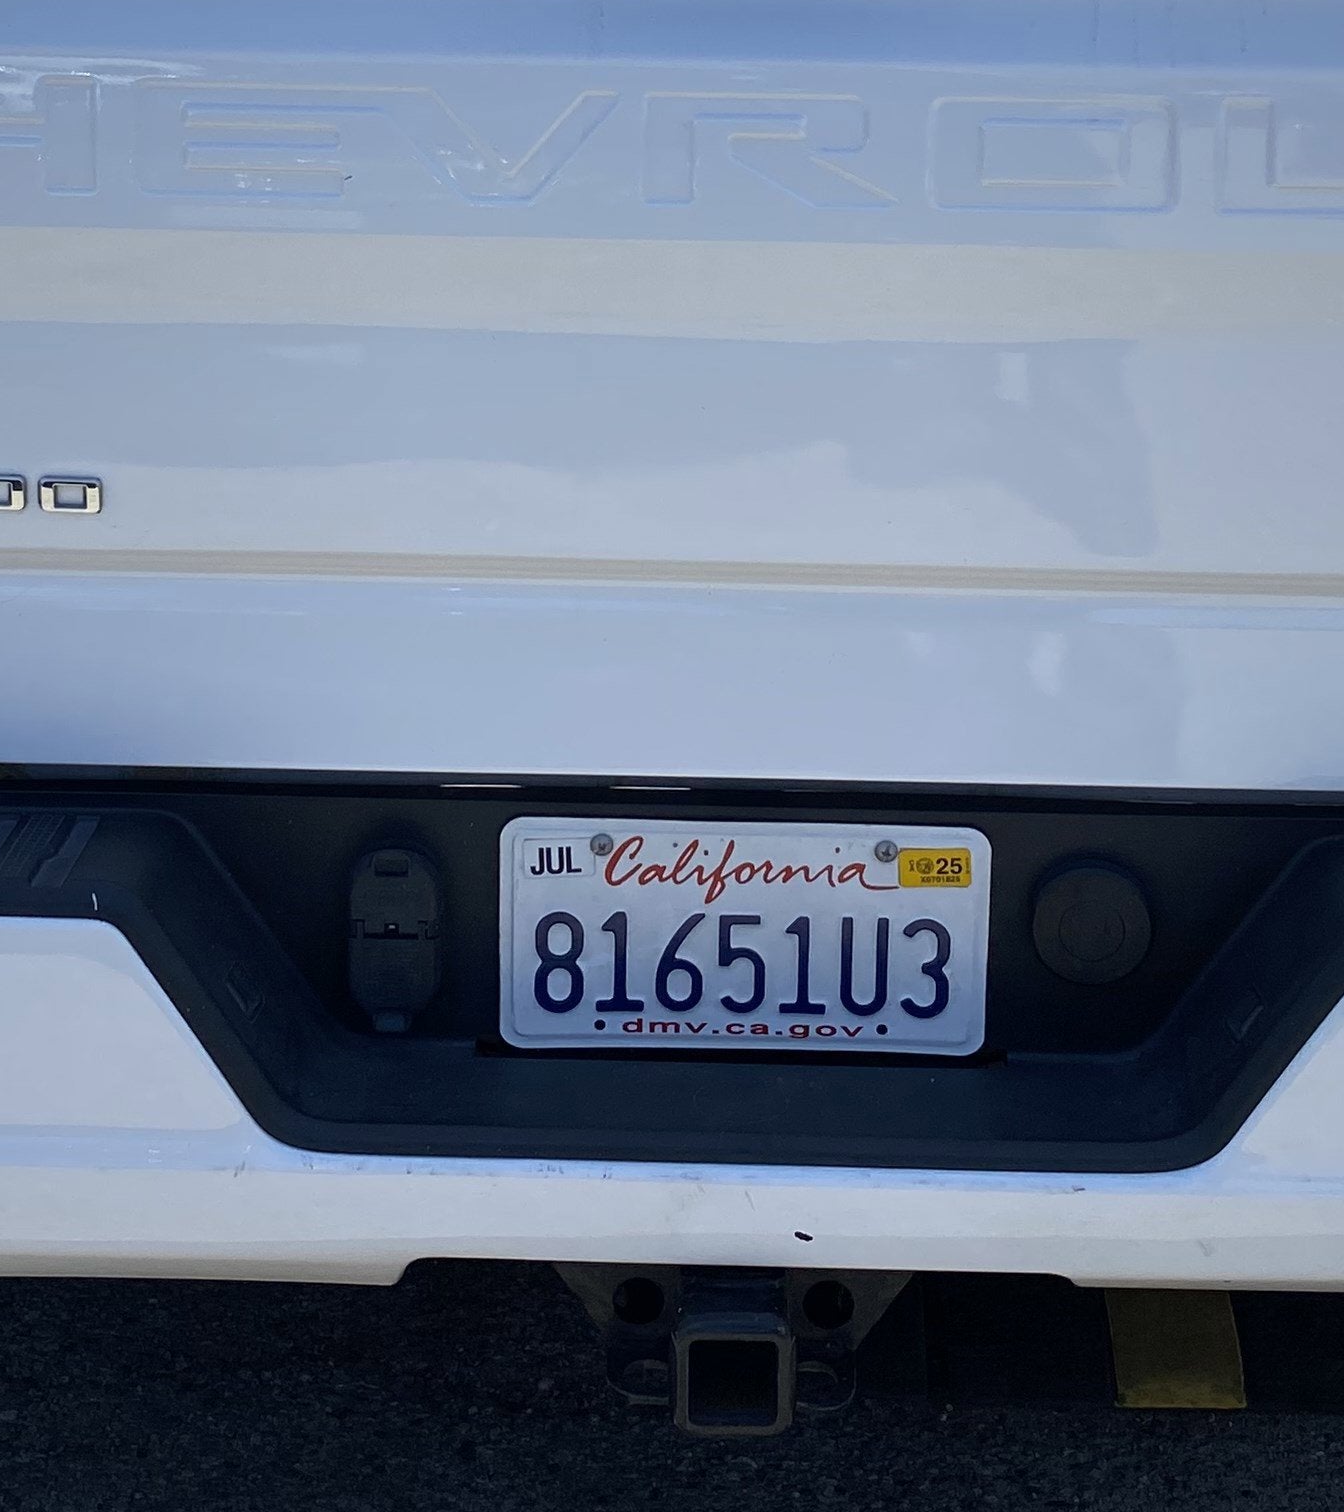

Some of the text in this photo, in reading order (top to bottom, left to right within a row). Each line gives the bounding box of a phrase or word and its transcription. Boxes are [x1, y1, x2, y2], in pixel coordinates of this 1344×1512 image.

[530, 845, 582, 875] JUL
[604, 835, 899, 904] California
[935, 857, 963, 875] 25
[533, 910, 952, 1020] 81651U3
[622, 1019, 864, 1039] dmv.ca.gov
